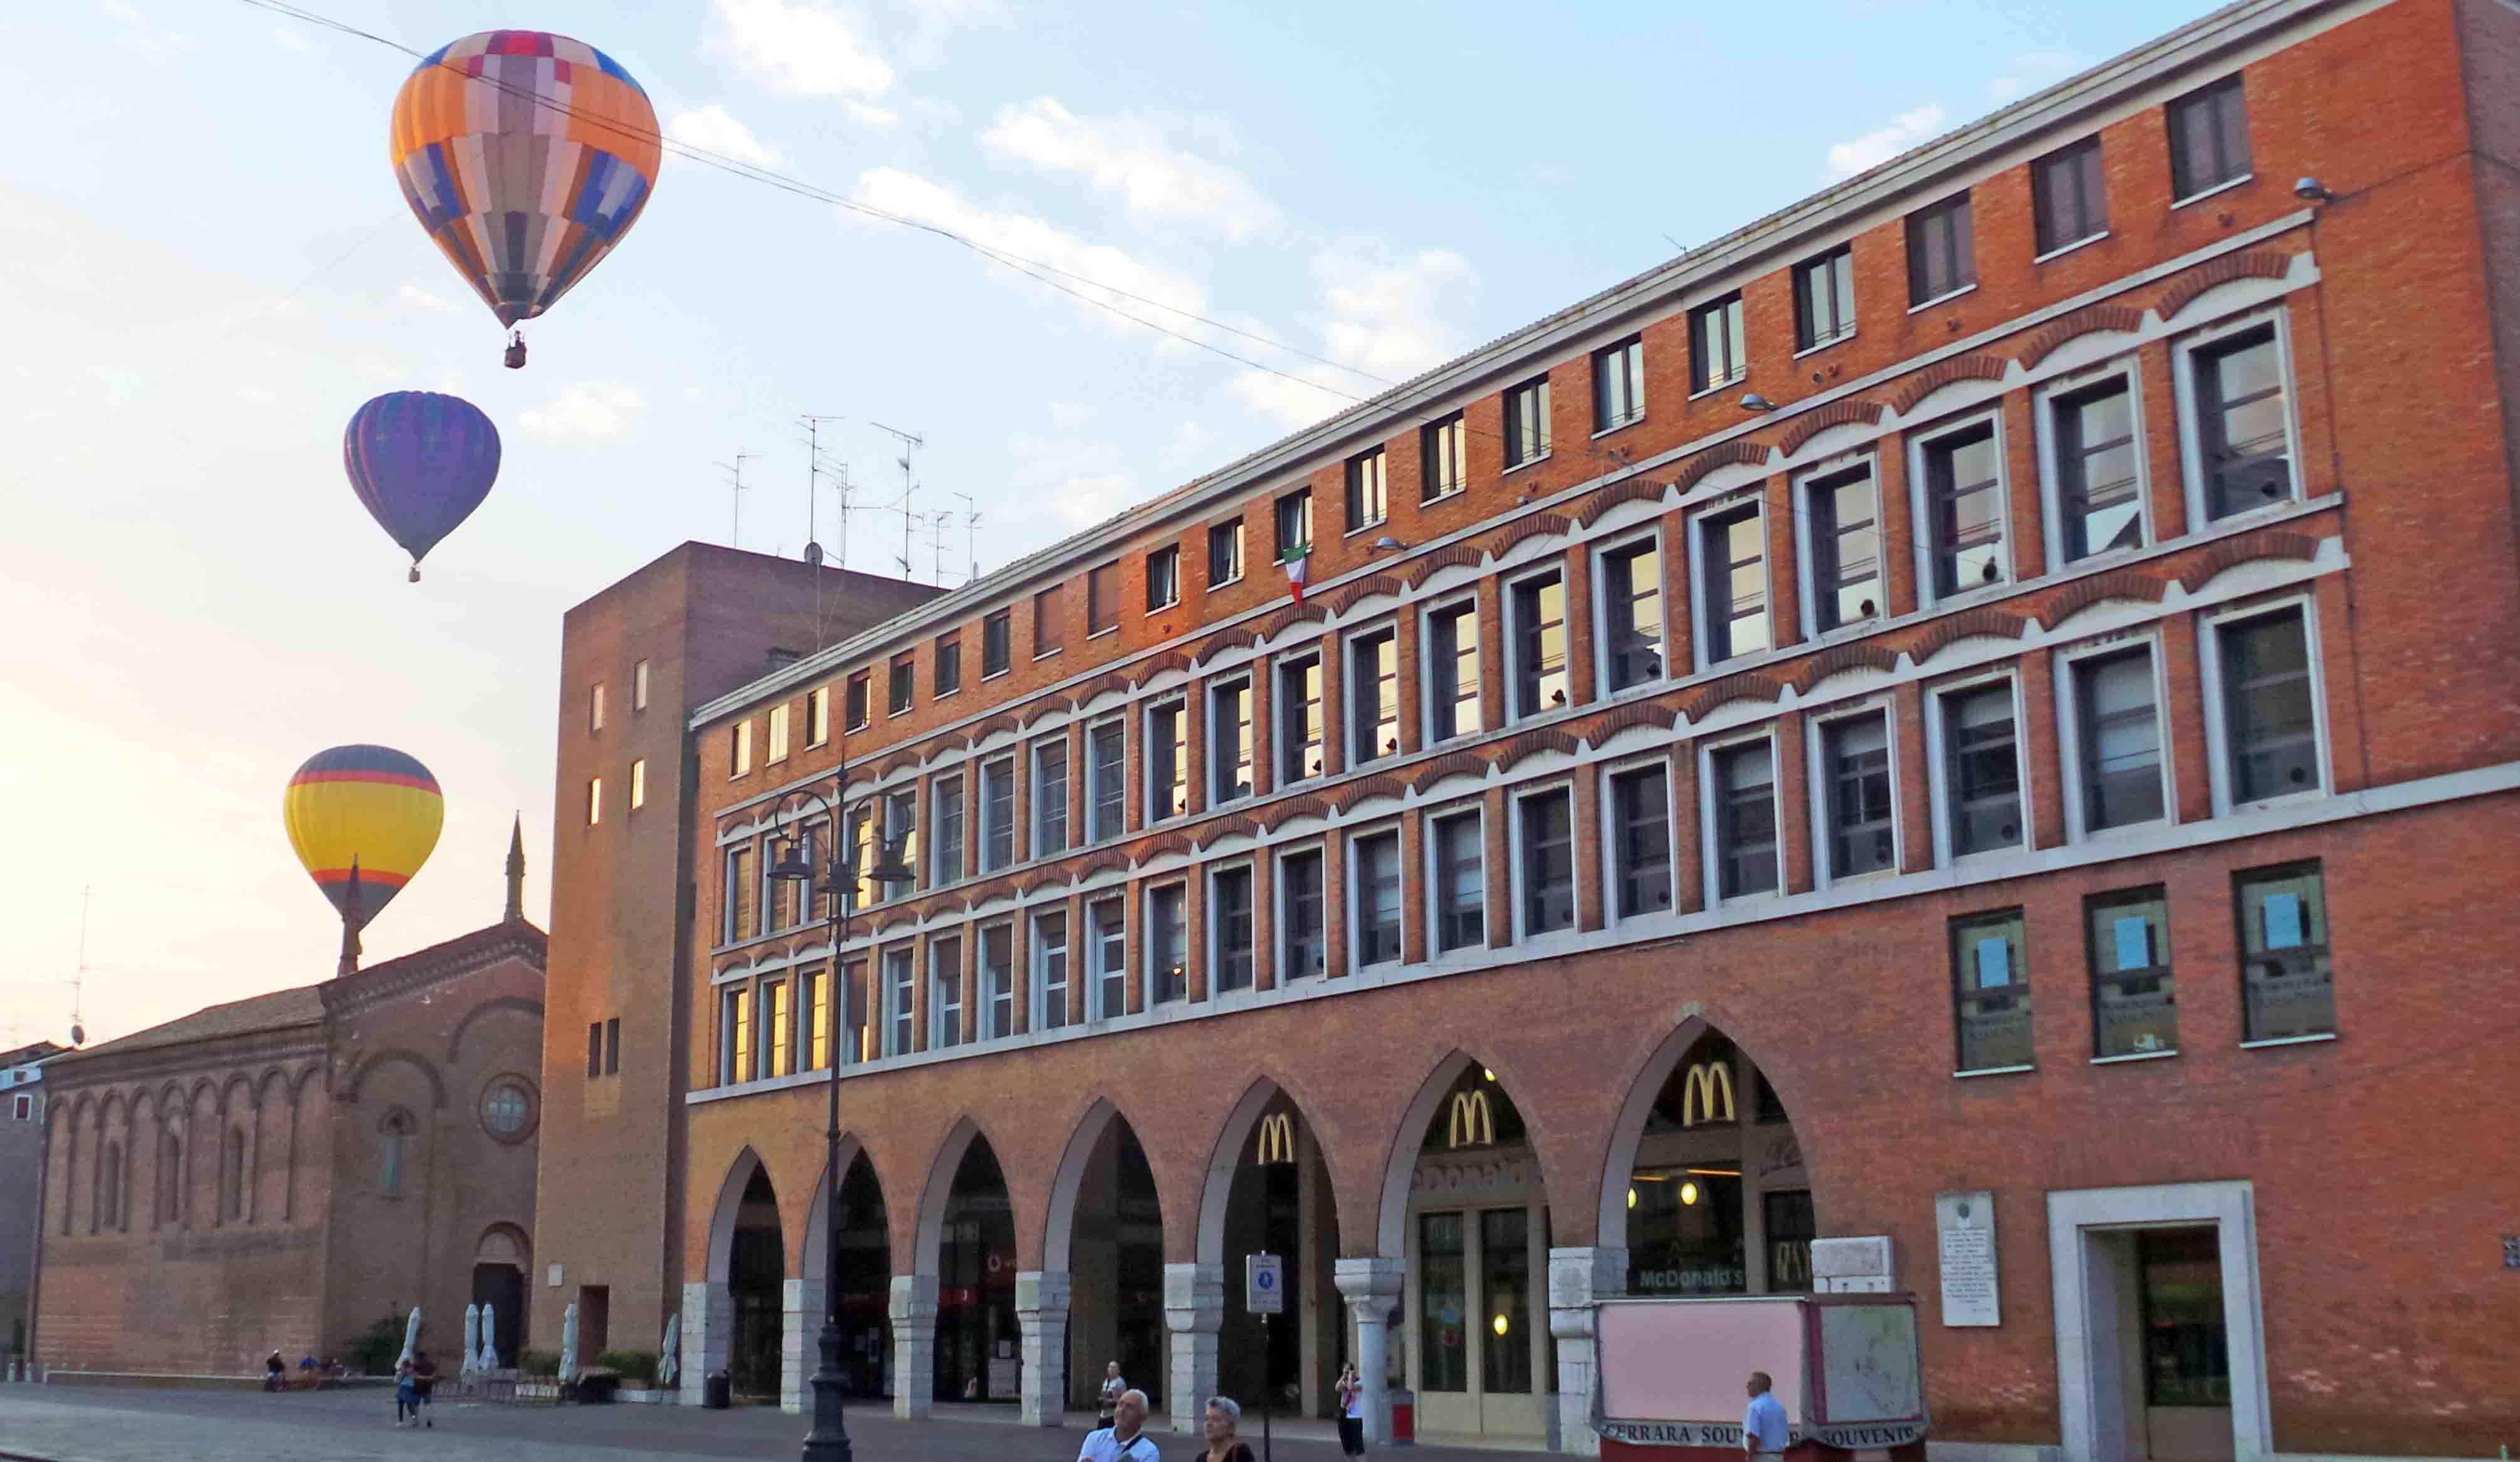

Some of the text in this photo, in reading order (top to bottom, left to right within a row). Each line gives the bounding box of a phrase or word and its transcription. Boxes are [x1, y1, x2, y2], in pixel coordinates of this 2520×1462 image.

[1449, 1090, 1492, 1148] M
[1684, 1061, 1735, 1127] M
[1258, 1112, 1293, 1165] M
[1640, 1268, 1743, 1287] McDonald's
[1604, 1424, 1691, 1441] FERRARA
